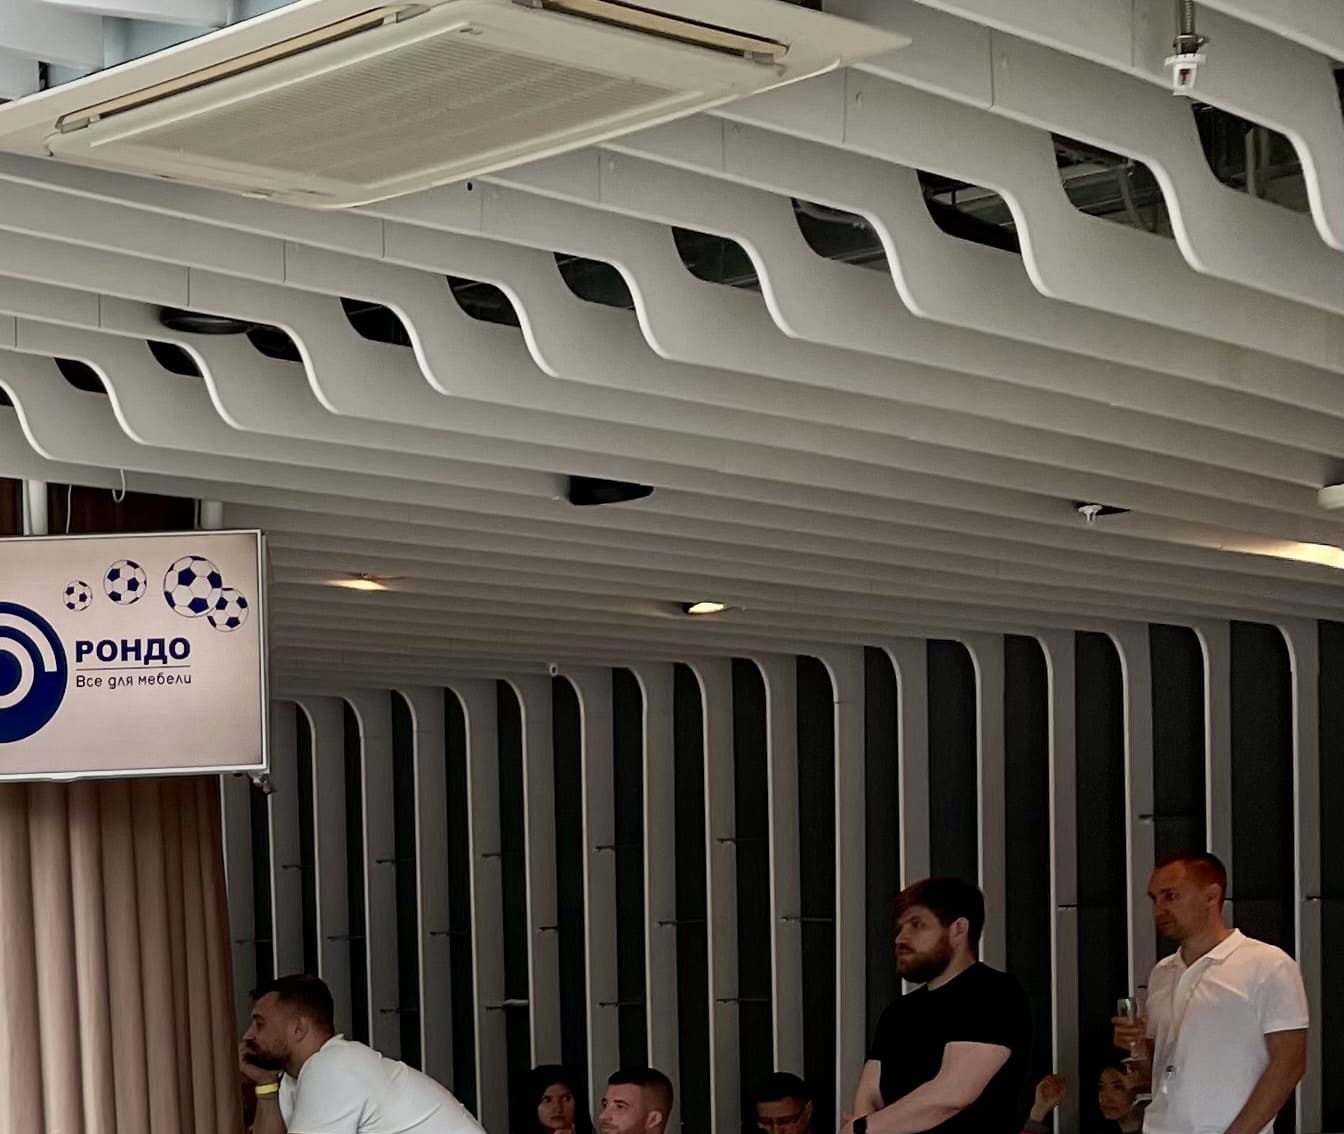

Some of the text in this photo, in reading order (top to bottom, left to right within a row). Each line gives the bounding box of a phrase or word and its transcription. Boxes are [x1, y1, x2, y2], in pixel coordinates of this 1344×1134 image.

[75, 637, 191, 665] РОНДО
[76, 672, 192, 689] Все для мебели
